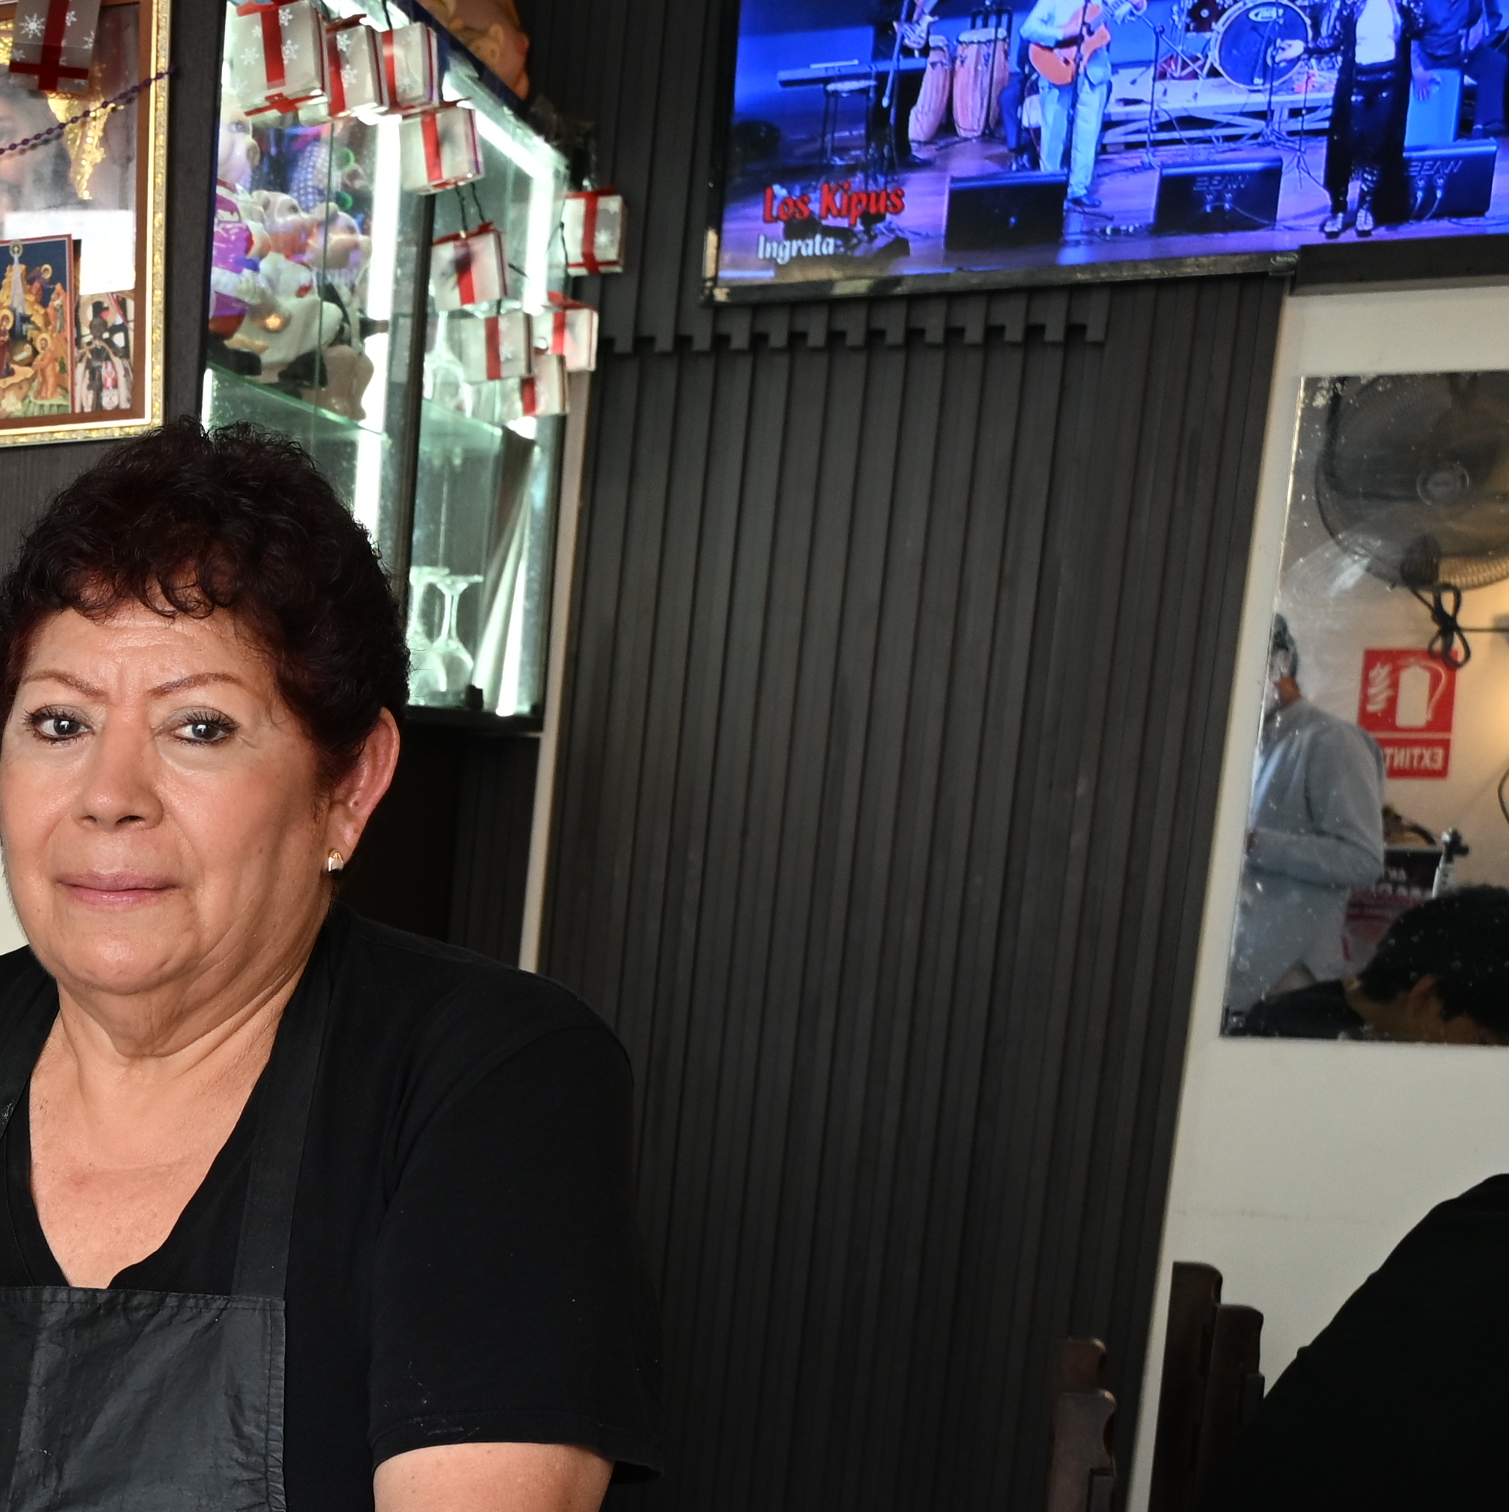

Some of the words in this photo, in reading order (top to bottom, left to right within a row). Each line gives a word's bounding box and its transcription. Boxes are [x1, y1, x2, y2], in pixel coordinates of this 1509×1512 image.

[763, 187, 811, 223] Los
[821, 181, 905, 226] Kipus
[758, 234, 835, 265] Ingrata
